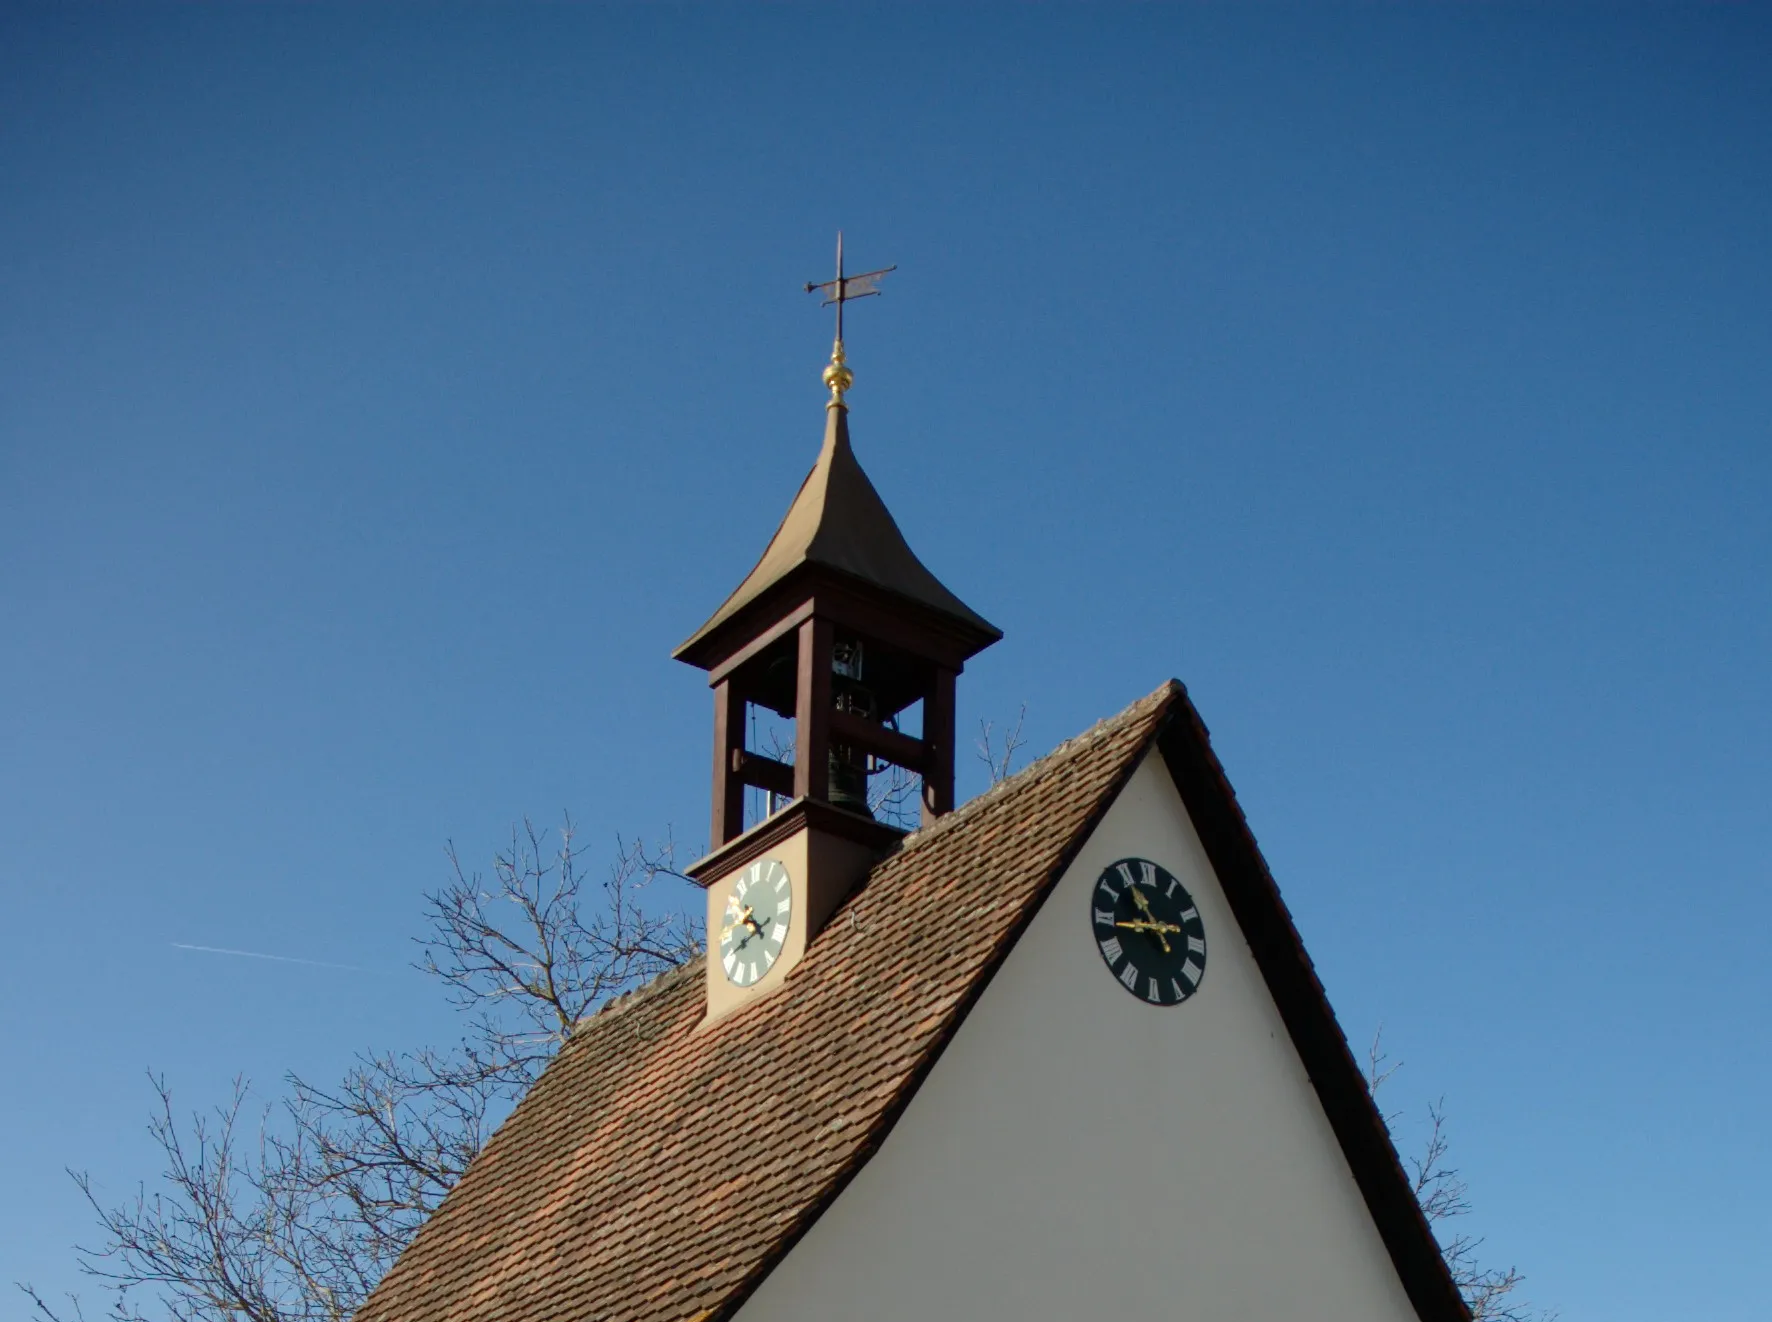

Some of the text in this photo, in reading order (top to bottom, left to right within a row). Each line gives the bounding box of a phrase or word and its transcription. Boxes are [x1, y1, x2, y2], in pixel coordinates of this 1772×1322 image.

[1116, 863, 1136, 888] XI
[1139, 862, 1157, 888] XII
[1100, 879, 1120, 903] X
[1165, 879, 1178, 899] I
[1095, 907, 1114, 926] IX
[1180, 906, 1198, 922] II
[1100, 936, 1123, 966] VIII
[1188, 935, 1204, 956] III
[1120, 961, 1138, 991] VII
[1181, 957, 1202, 987] IIII
[1148, 977, 1161, 1002] VI
[1172, 977, 1186, 1001] V
